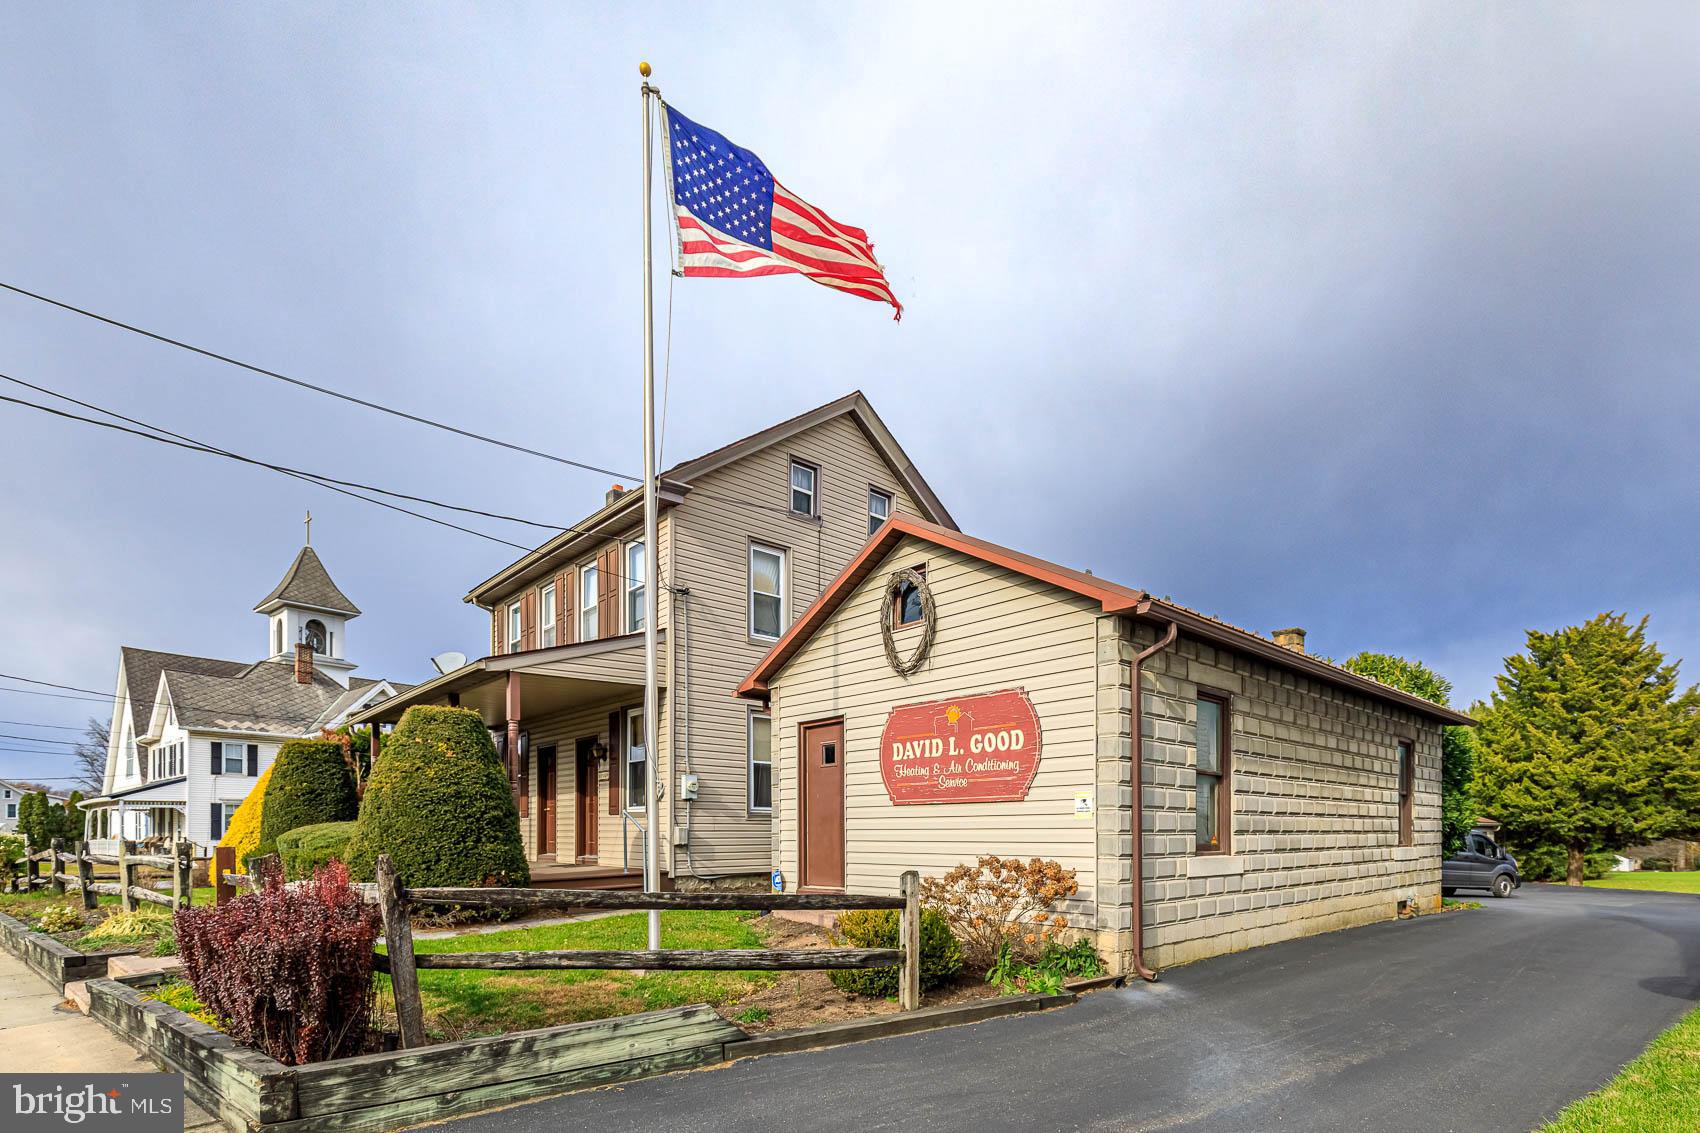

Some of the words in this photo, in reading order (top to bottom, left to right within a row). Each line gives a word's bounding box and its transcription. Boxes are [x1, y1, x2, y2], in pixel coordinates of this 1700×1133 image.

[892, 738, 943, 761] DAVID
[949, 736, 964, 756] L.
[970, 729, 1024, 754] GOOD
[894, 764, 929, 779] Heating
[933, 763, 941, 775] &
[943, 760, 962, 775] Air
[965, 757, 1020, 774] Conditioning
[938, 774, 968, 789] Service
